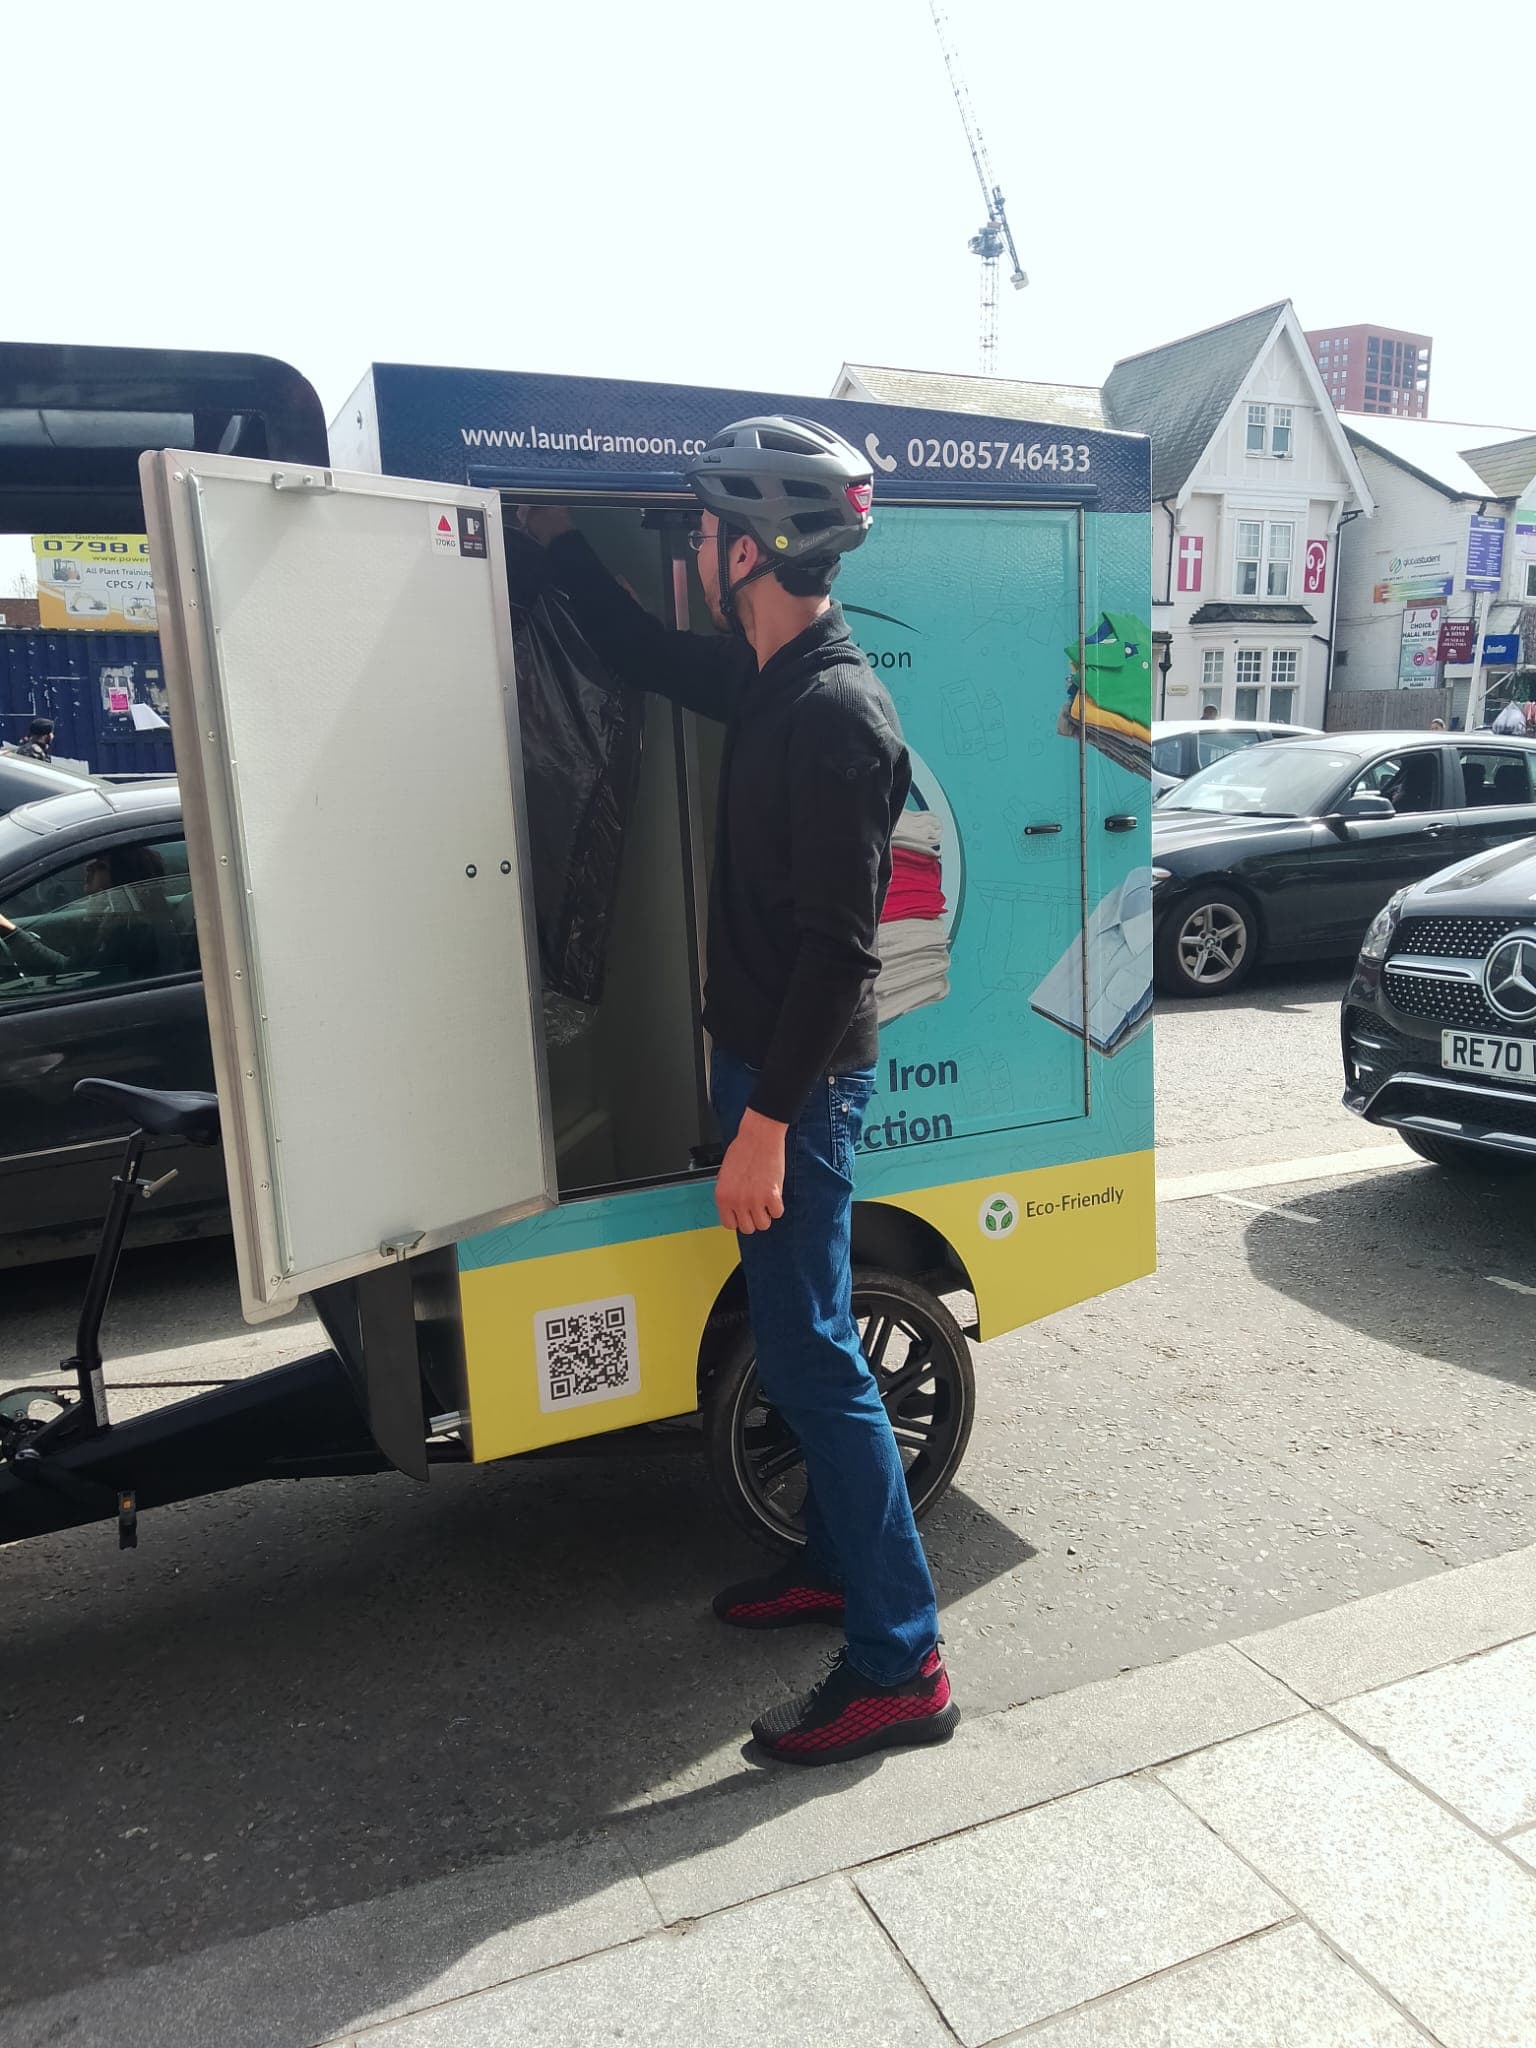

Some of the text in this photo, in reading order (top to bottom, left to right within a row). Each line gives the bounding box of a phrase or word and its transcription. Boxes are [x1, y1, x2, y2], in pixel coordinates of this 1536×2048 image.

[907, 438, 1091, 473] 02085746433
[43, 540, 128, 553] 0798
[99, 567, 119, 575] Plant
[106, 580, 134, 589] CPCS
[1453, 1035, 1522, 1072] RE70
[888, 1058, 958, 1092] Iron
[855, 1110, 953, 1151] ction
[1026, 1186, 1124, 1218] Eco-Friendly
